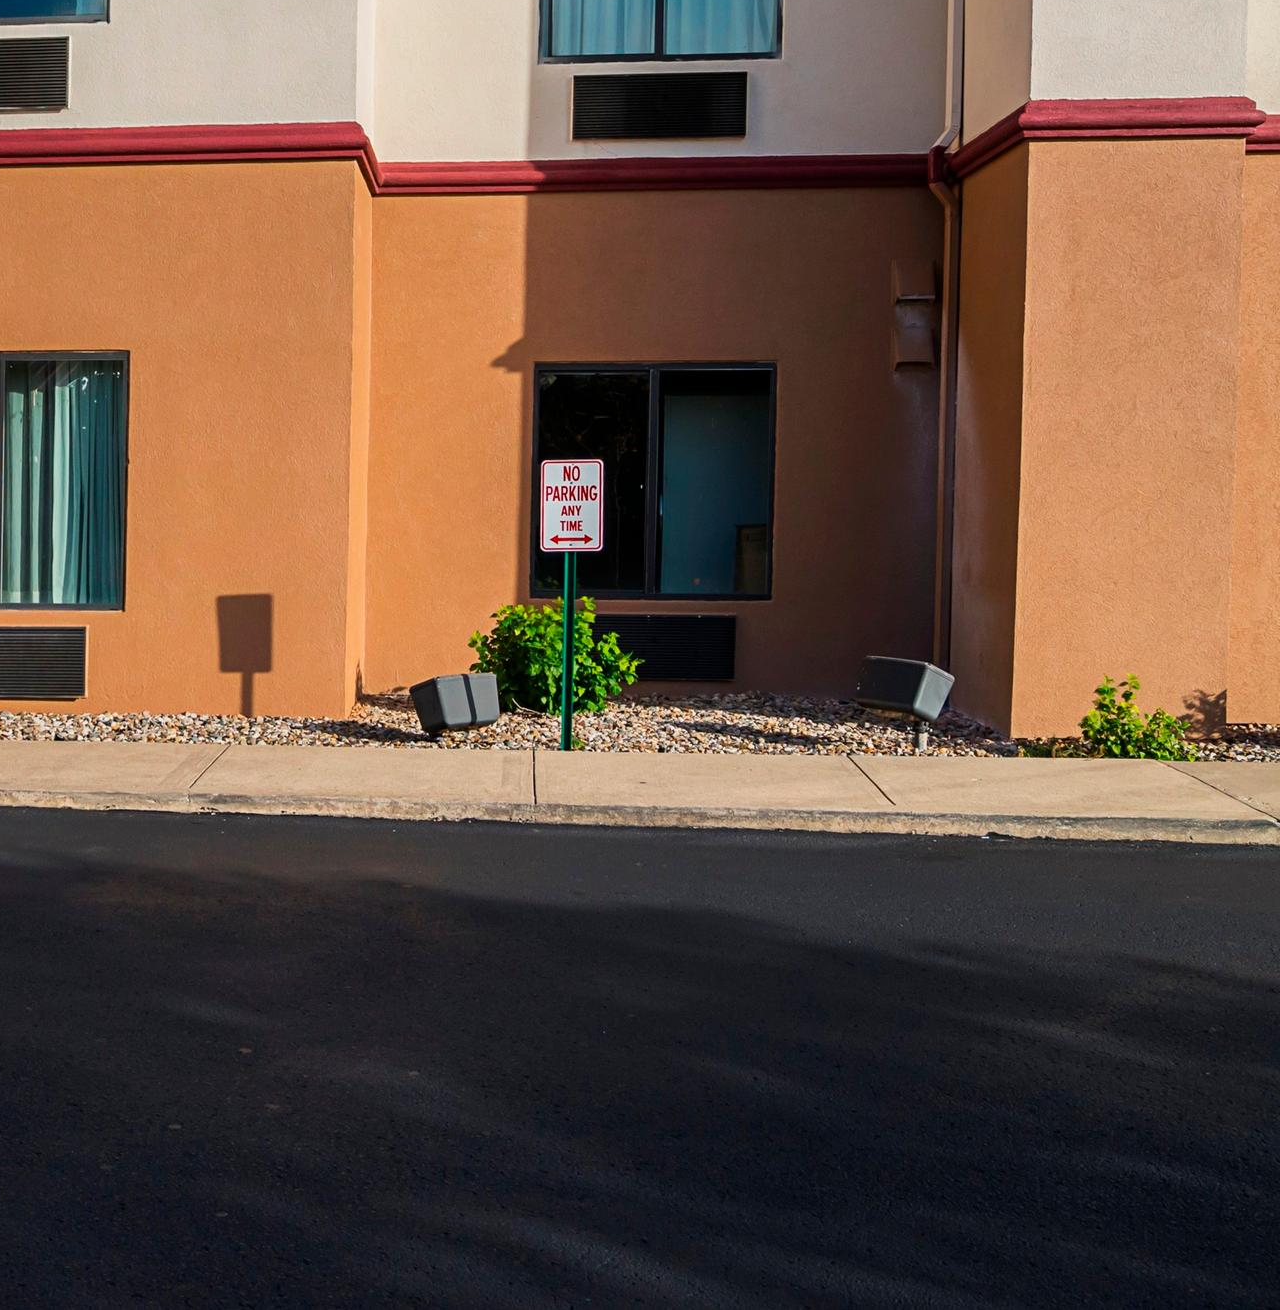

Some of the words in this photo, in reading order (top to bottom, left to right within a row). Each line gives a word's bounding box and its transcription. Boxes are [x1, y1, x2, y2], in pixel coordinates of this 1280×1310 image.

[563, 465, 581, 482] NO
[545, 485, 598, 502] PARKING
[561, 505, 582, 516] ANY
[560, 520, 583, 531] TIME
